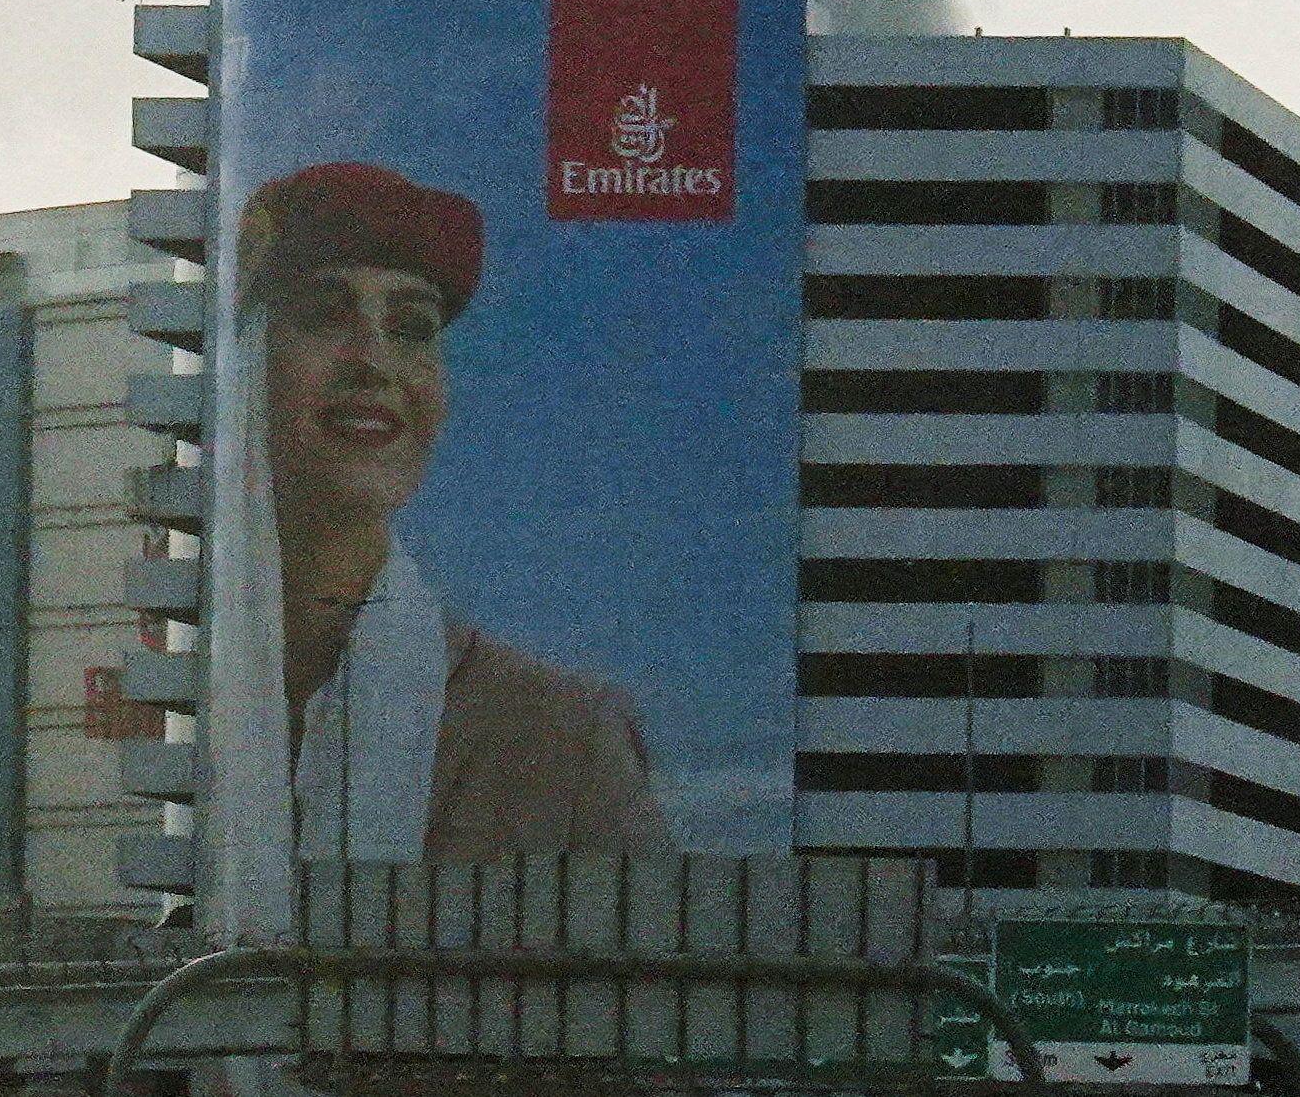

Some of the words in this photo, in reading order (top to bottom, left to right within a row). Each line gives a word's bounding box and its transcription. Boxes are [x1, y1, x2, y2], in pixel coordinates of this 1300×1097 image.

[560, 160, 722, 195] Emirates
[1105, 929, 1174, 953] مراكش
[1186, 932, 1237, 956] شارع
